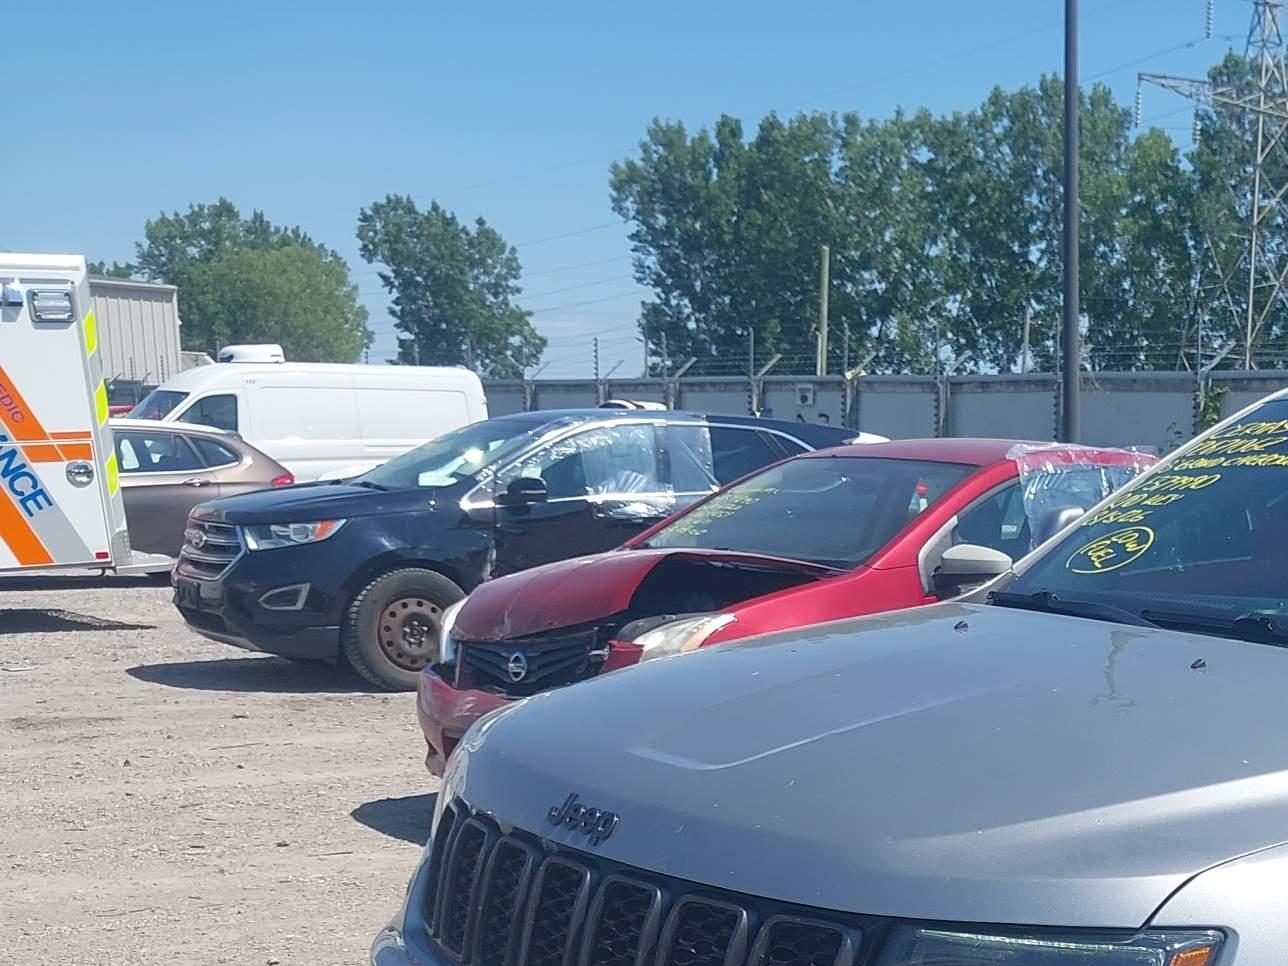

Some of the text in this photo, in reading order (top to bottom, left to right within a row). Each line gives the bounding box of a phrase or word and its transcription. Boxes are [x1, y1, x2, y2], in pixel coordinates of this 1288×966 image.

[1080, 539, 1118, 569] FUEL
[1110, 529, 1147, 553] LOW
[546, 791, 622, 847] Jeep
